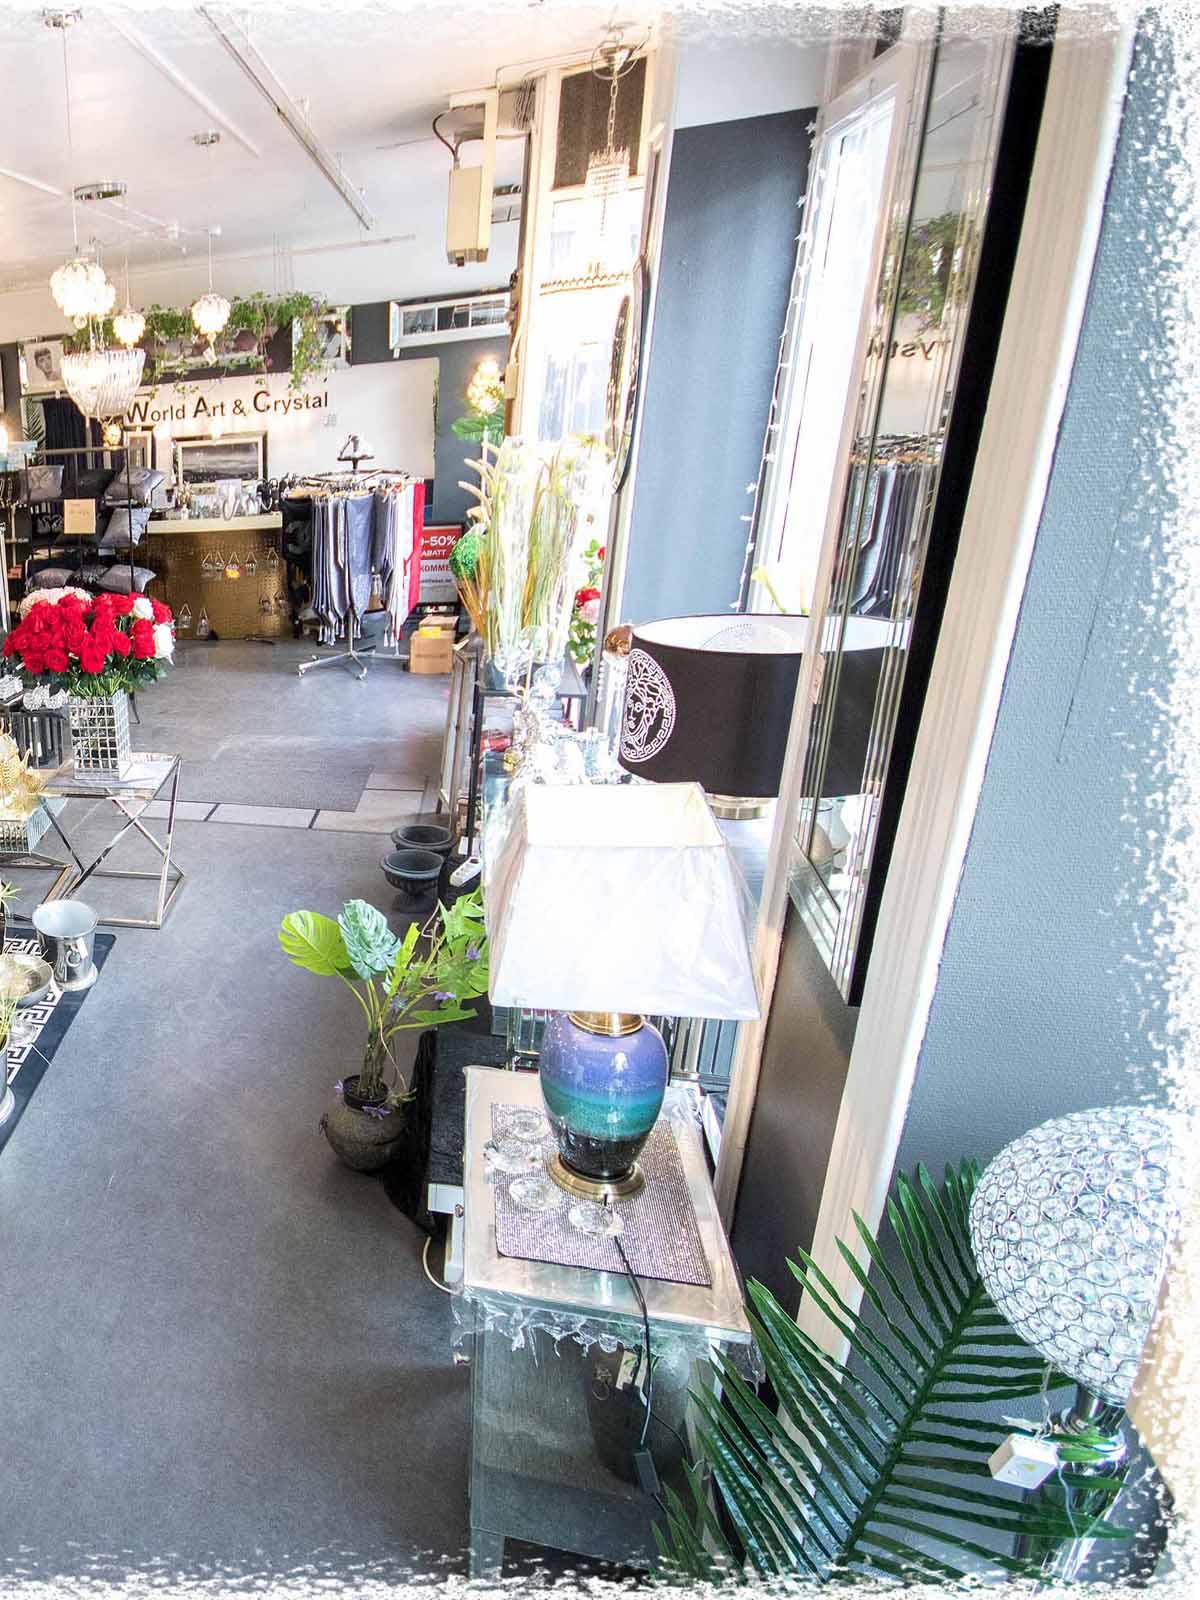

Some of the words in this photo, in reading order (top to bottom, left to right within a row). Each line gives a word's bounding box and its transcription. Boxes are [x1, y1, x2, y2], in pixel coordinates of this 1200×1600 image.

[127, 401, 186, 423] World
[193, 396, 225, 418] Art
[232, 399, 247, 417] &
[253, 390, 328, 415] Crystal
